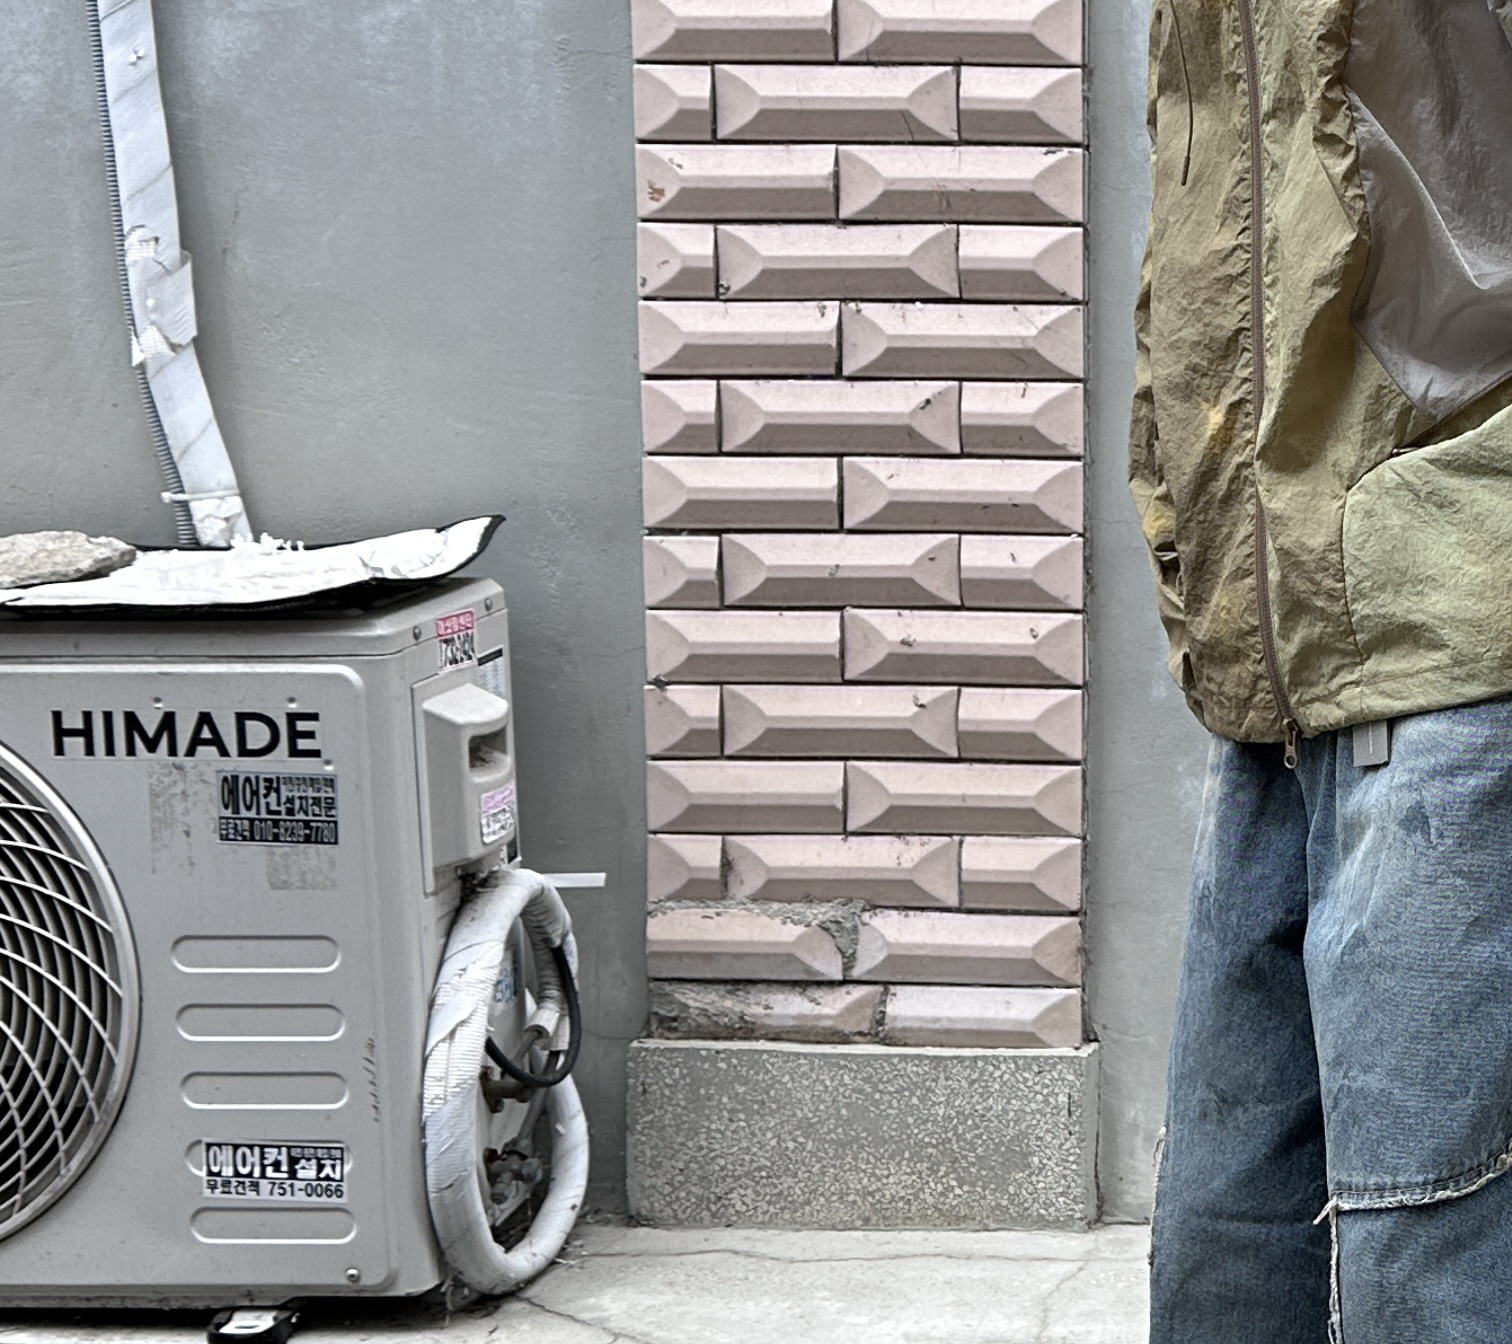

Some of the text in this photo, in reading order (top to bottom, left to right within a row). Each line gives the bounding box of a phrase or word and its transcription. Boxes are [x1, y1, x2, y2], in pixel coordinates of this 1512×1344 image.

[51, 709, 322, 759] HIMADE
[221, 774, 282, 816] 에어컨
[208, 1145, 289, 1178] 에어컨
[206, 1179, 344, 1199] 무료견적 751-0066
